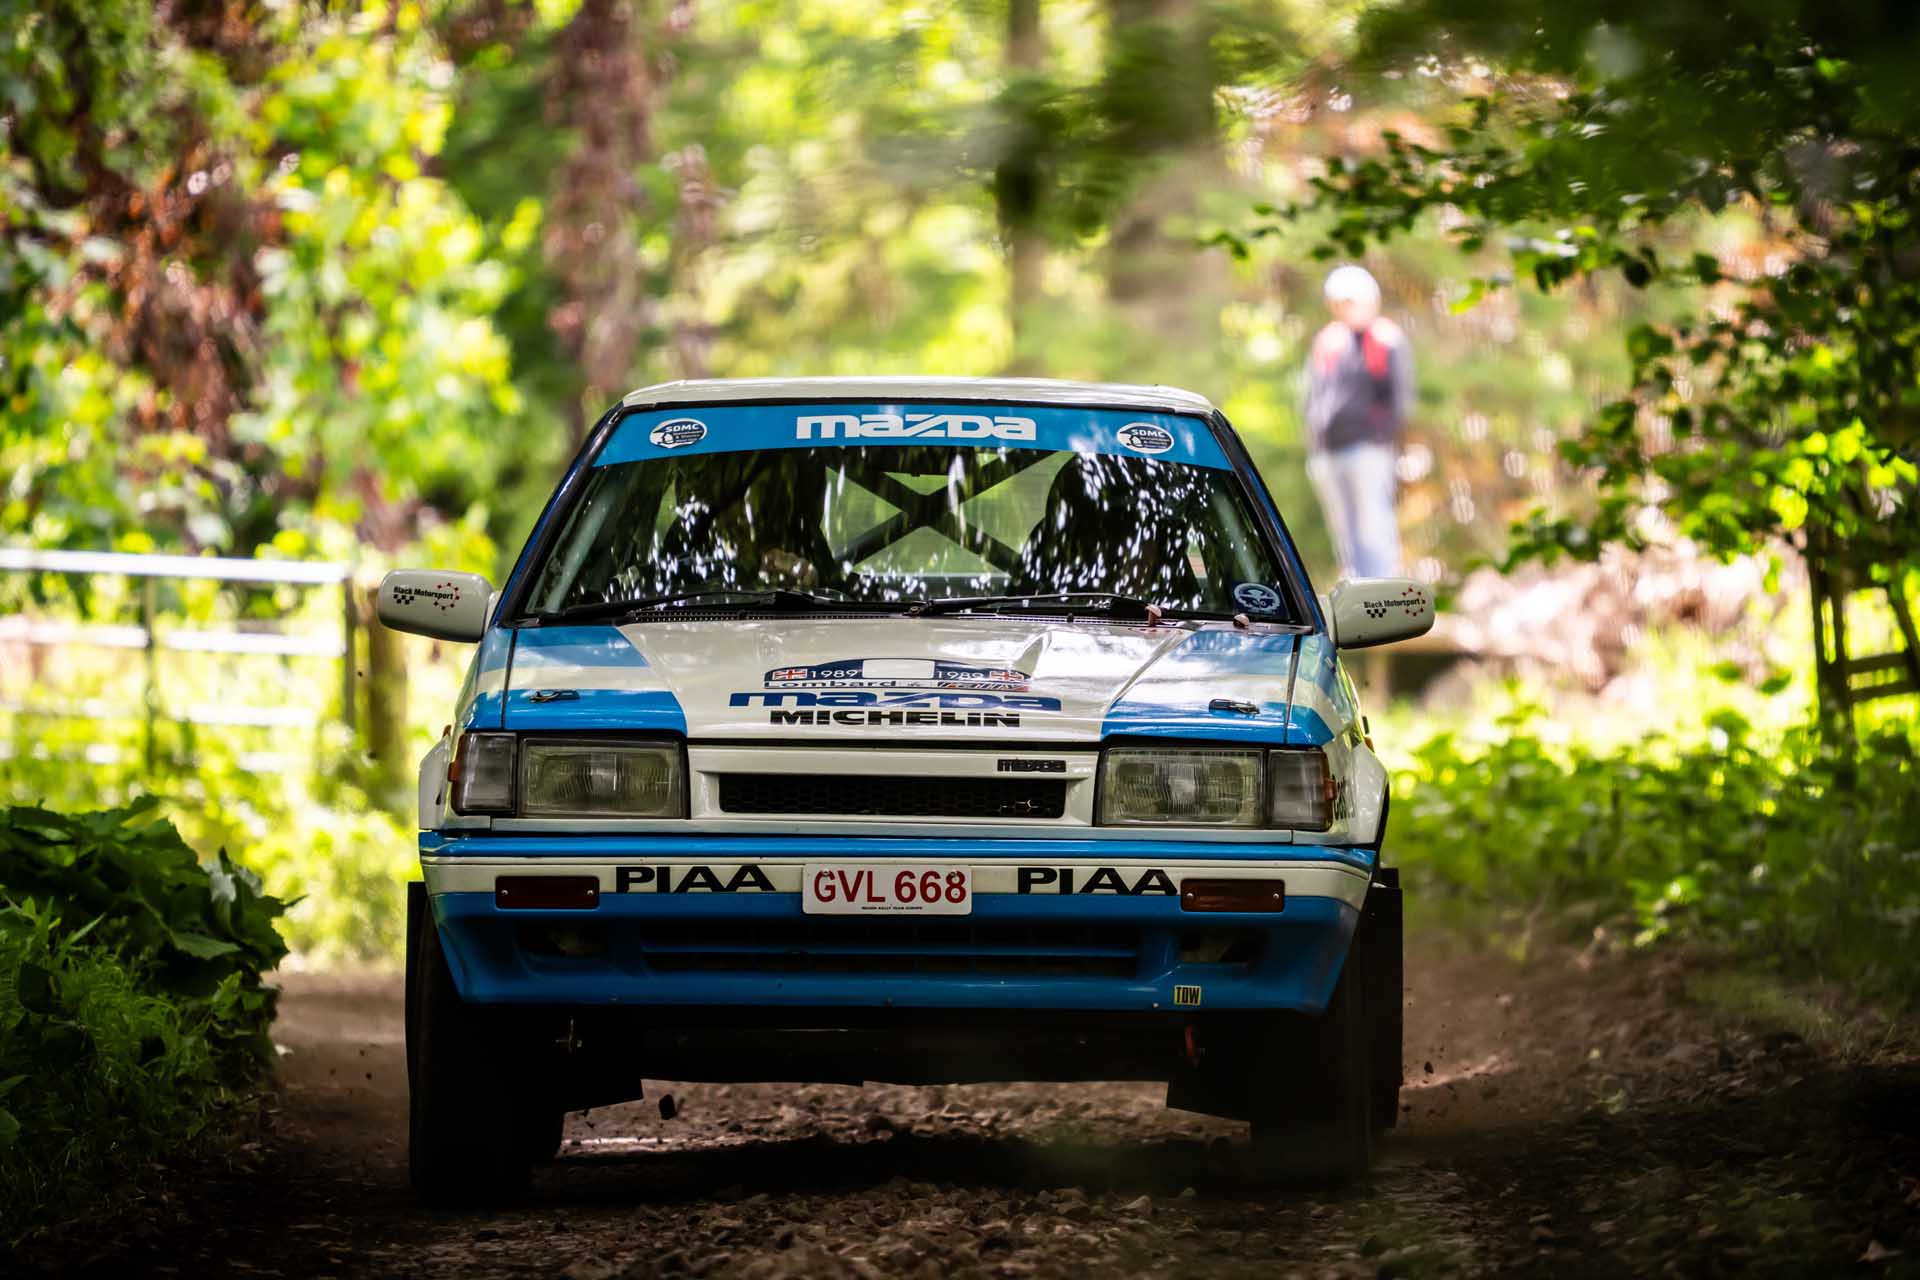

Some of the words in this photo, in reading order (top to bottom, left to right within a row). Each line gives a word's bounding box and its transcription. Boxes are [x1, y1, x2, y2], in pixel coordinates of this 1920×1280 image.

[665, 424, 699, 433] SDMC
[1131, 429, 1166, 438] SDMC
[394, 586, 412, 595] Black
[414, 588, 454, 600] Motorsport
[1384, 598, 1420, 607] Motorsport
[811, 669, 858, 678] 1989
[938, 670, 984, 680] 1989
[764, 680, 896, 688] Lombard
[770, 710, 1020, 727] MICHELIN
[616, 865, 776, 893] PIAA
[1018, 867, 1178, 895] PIAA
[814, 870, 886, 903] GVL
[894, 870, 967, 904] 668
[1176, 986, 1200, 1004] TOW
